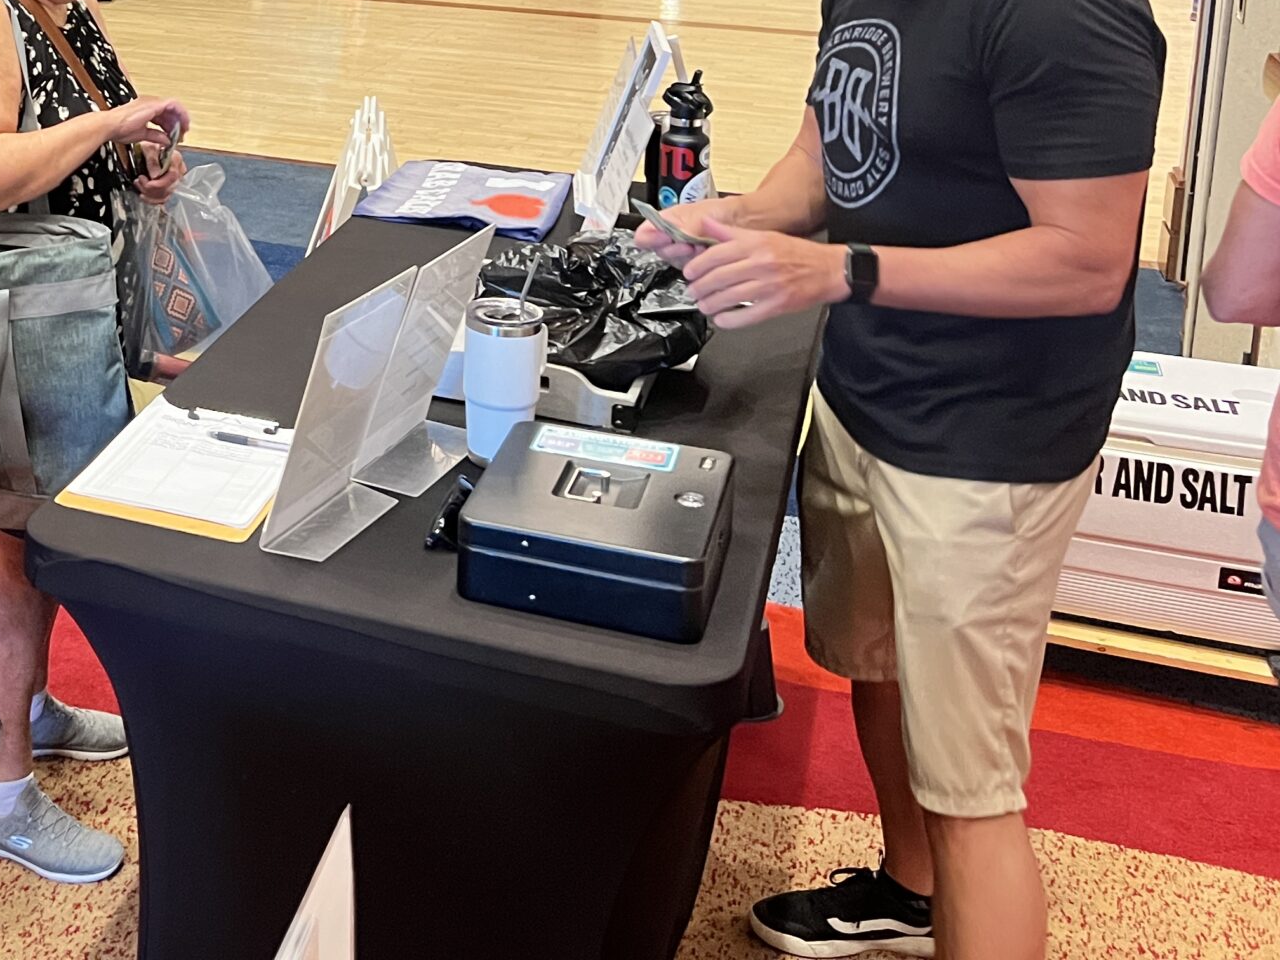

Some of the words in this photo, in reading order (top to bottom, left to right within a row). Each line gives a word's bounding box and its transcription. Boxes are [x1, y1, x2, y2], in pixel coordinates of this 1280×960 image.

[866, 147, 890, 189] ALES
[1170, 394, 1241, 416] SALT
[1112, 457, 1175, 505] AND
[1180, 468, 1253, 517] SALT
